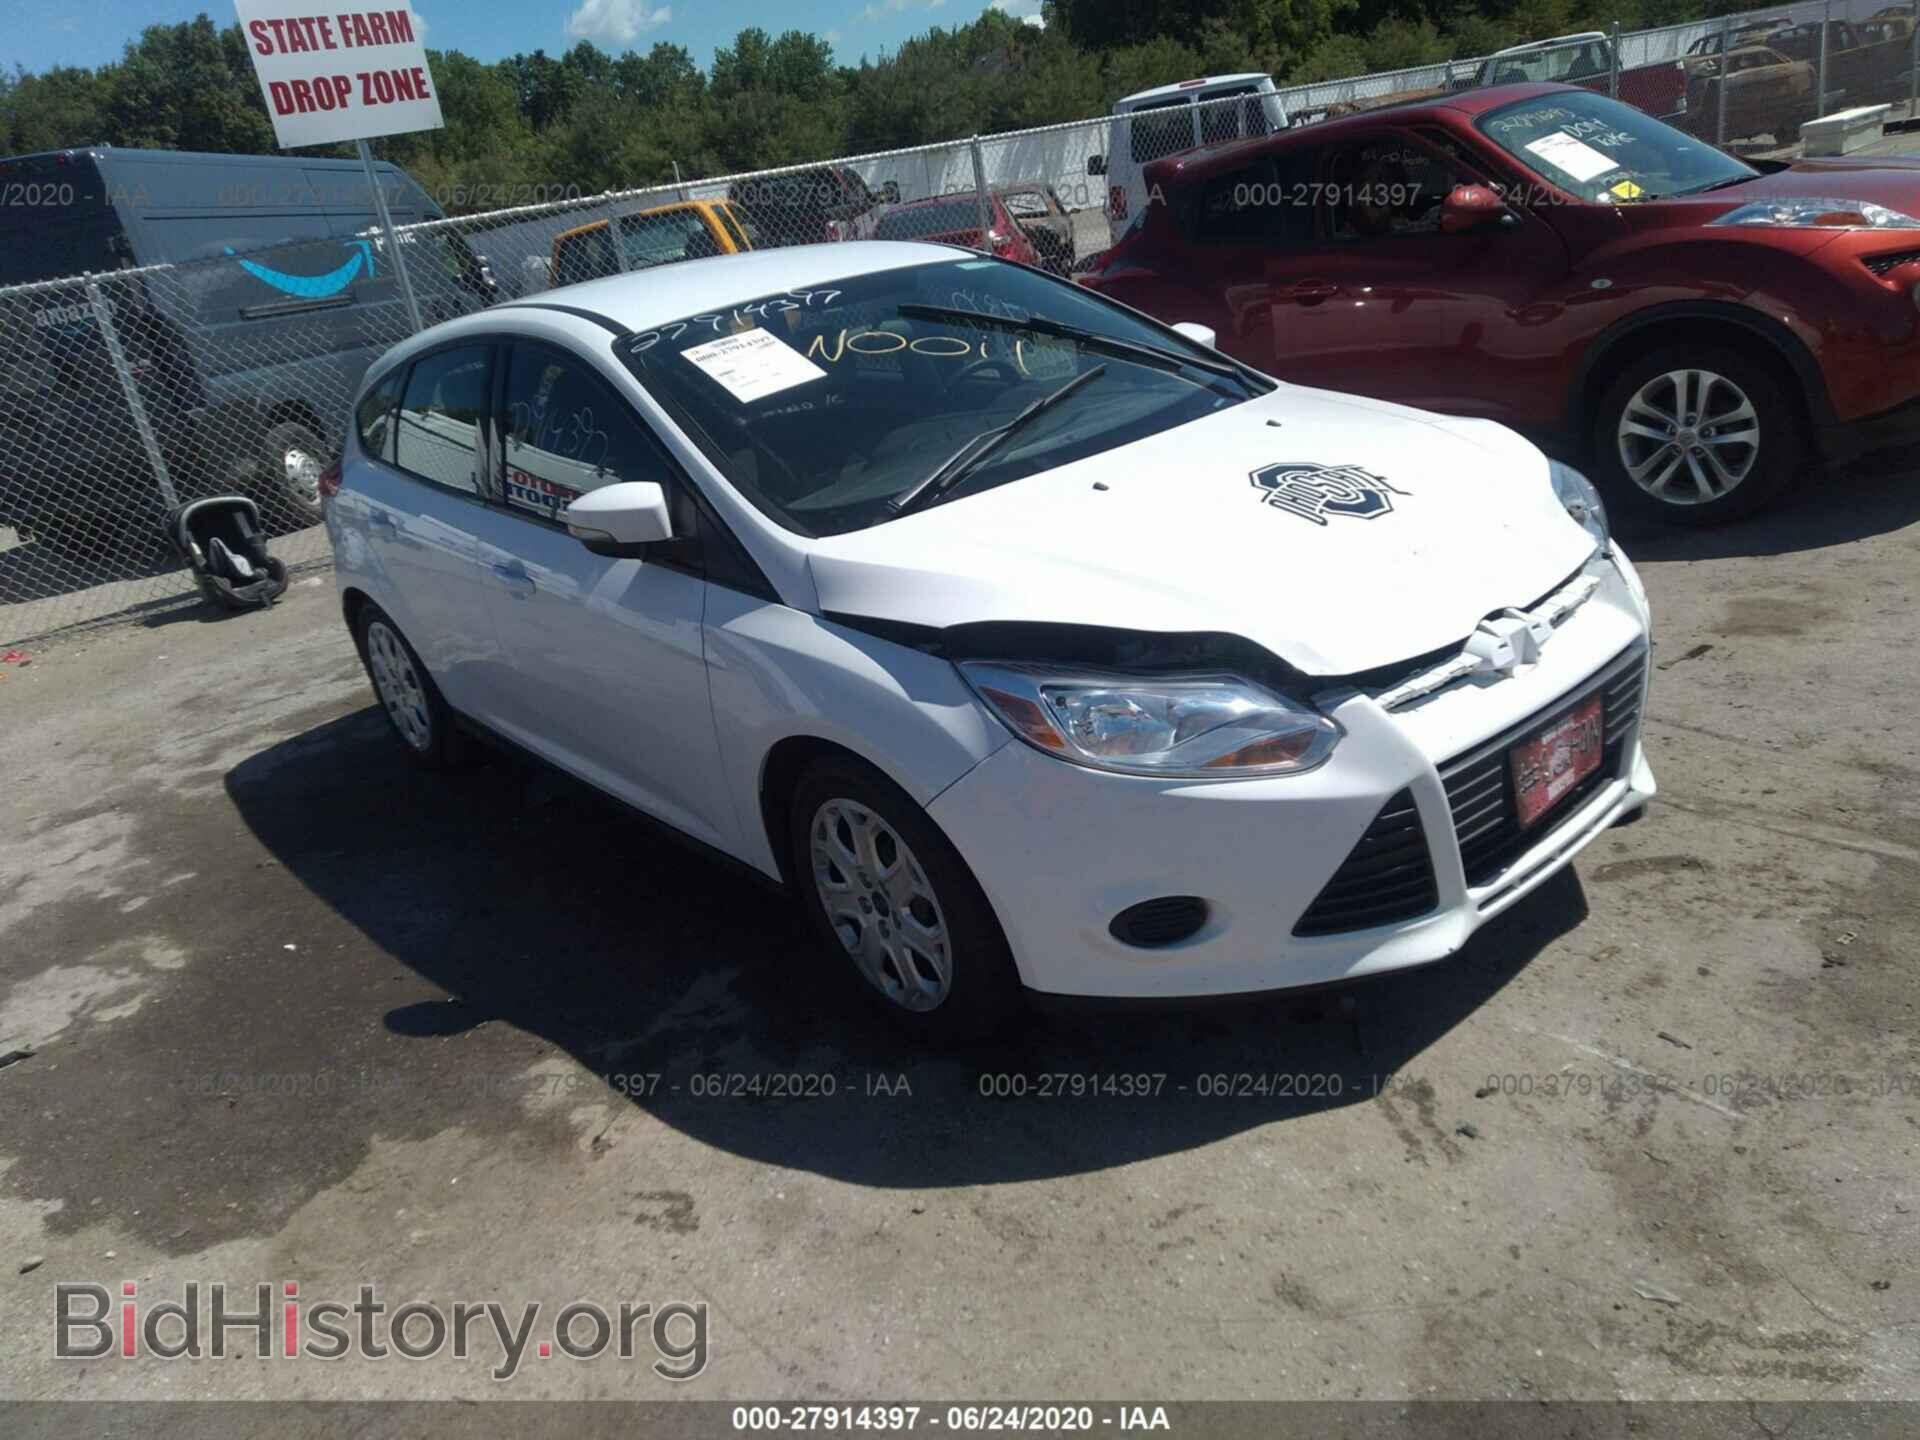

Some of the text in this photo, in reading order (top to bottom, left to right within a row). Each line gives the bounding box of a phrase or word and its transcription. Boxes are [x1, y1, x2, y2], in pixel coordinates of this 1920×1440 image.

[249, 10, 414, 56] STATE FARM
[268, 67, 430, 116] DROP ZONE
[630, 290, 841, 352] 27914397
